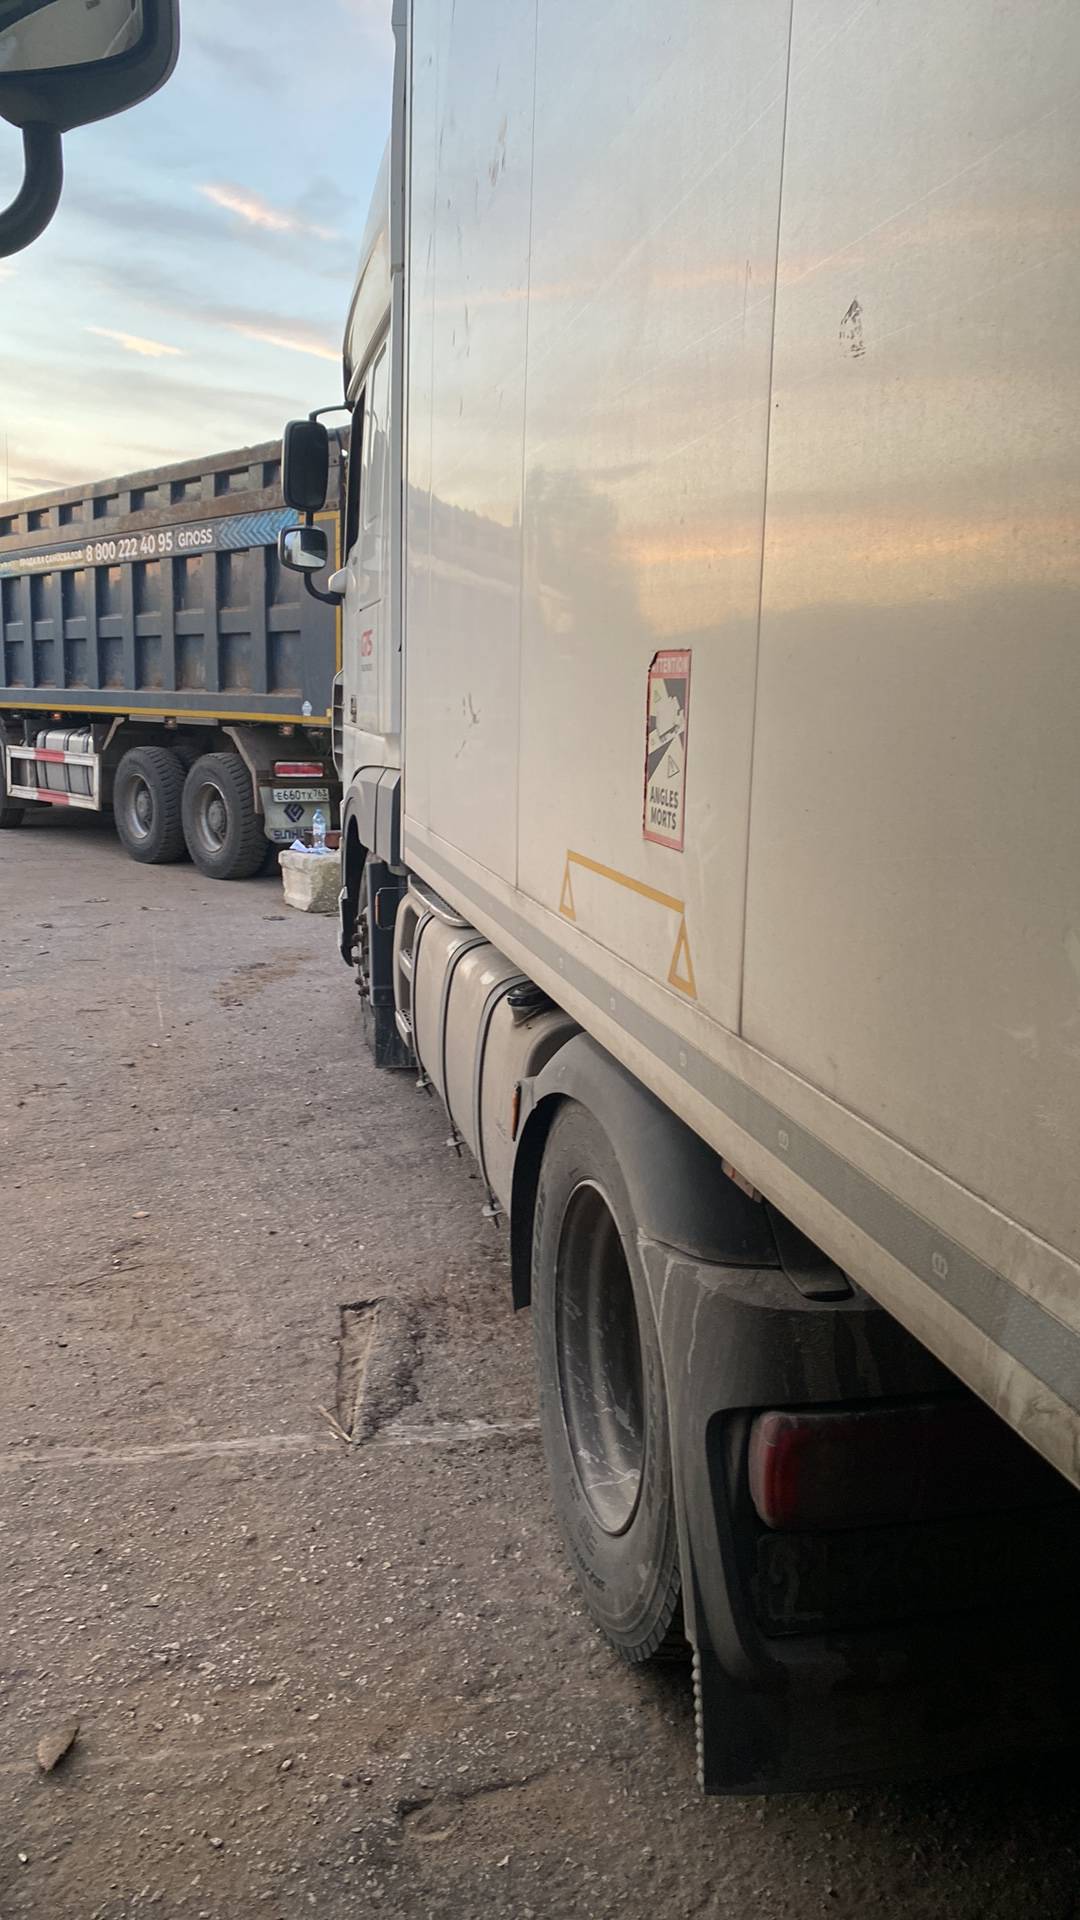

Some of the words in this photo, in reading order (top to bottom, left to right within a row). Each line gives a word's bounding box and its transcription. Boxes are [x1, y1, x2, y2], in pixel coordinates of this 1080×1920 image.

[86, 544, 93, 562] 8
[95, 542, 116, 561] 800
[118, 538, 138, 558] 222
[140, 535, 156, 555] 40
[158, 532, 173, 552] 95
[650, 786, 679, 809] ANGLES
[650, 806, 677, 830] MORTS
